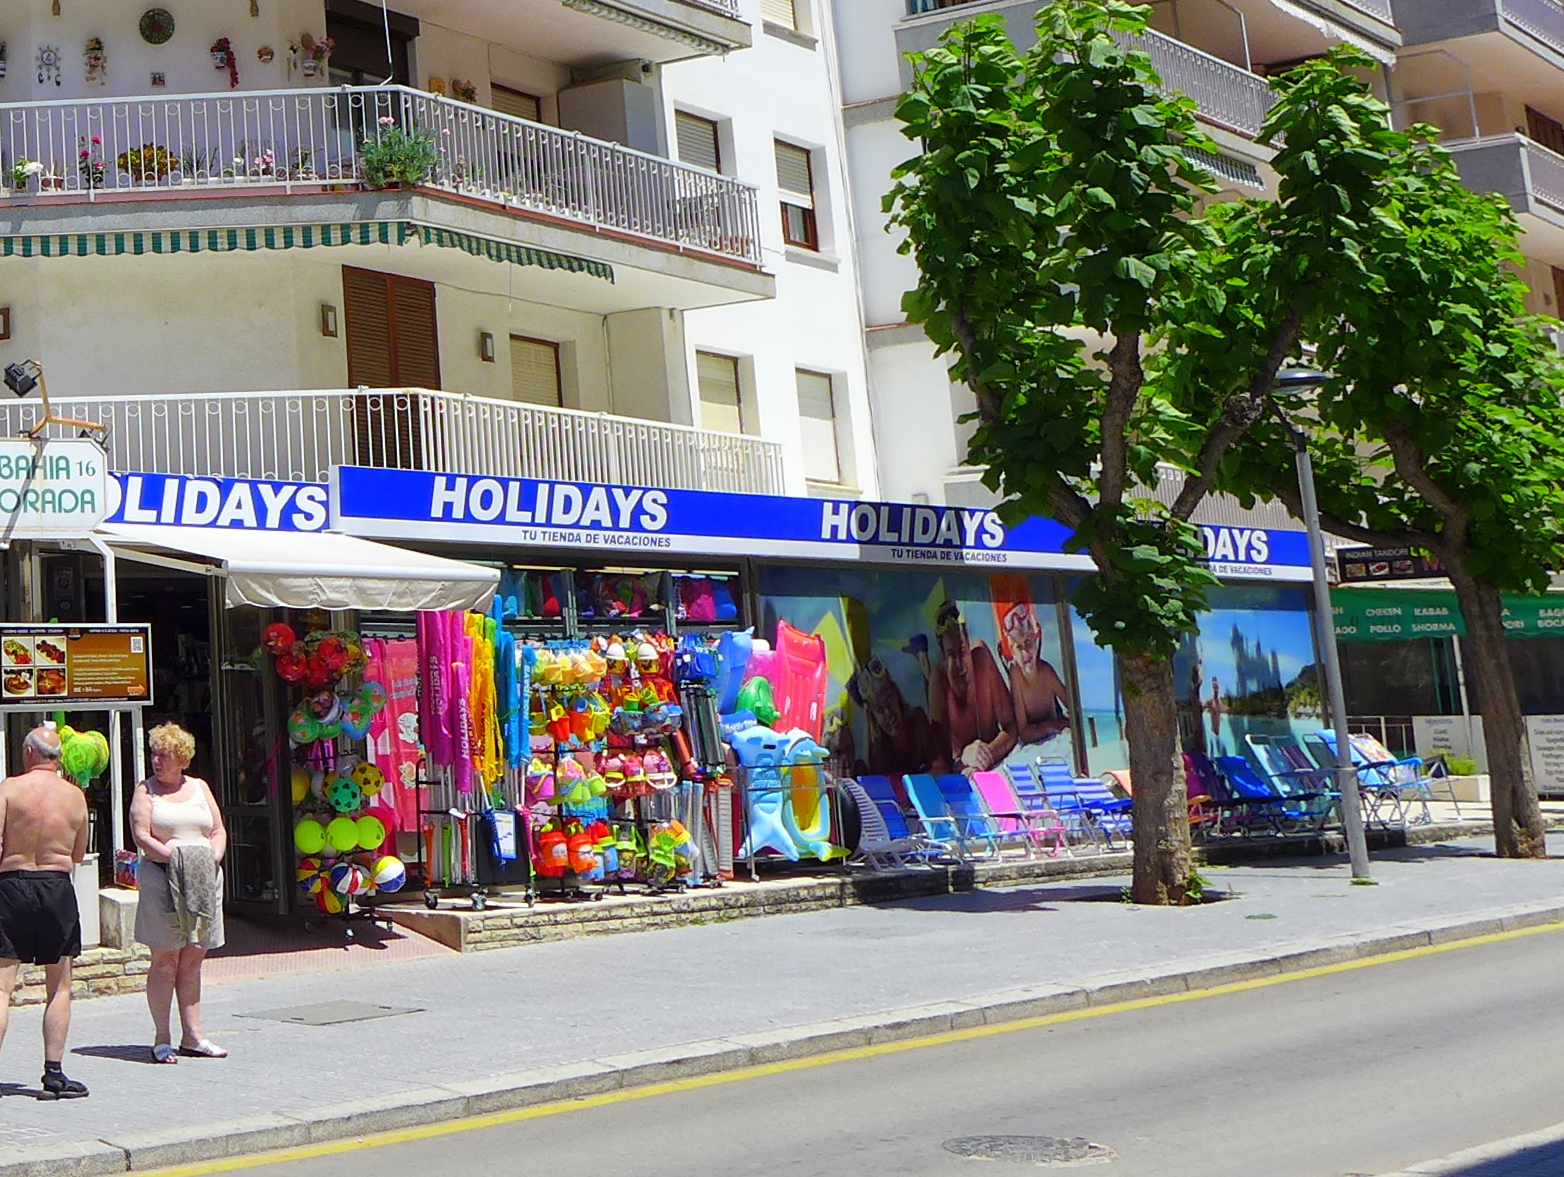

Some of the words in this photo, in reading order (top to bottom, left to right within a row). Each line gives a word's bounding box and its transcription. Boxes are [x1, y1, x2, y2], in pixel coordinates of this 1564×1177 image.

[76, 460, 96, 477] 16
[105, 473, 328, 531] LIDAYS
[430, 475, 669, 531] HOLIDAYS
[522, 529, 537, 541] TU
[541, 530, 582, 544] TIENDA
[586, 533, 600, 545] DE
[603, 534, 672, 548] VACACIONES
[821, 502, 1004, 548] HOLIDAYS
[891, 548, 904, 559] TU
[906, 549, 937, 560] TIENDA
[941, 550, 951, 561] DE
[954, 551, 1007, 563] VACACIONES
[1193, 526, 1270, 563] DAYS
[1414, 607, 1449, 616] KABAB
[1370, 624, 1402, 633] POLLO
[458, 697, 470, 759] HOLIDAYS
